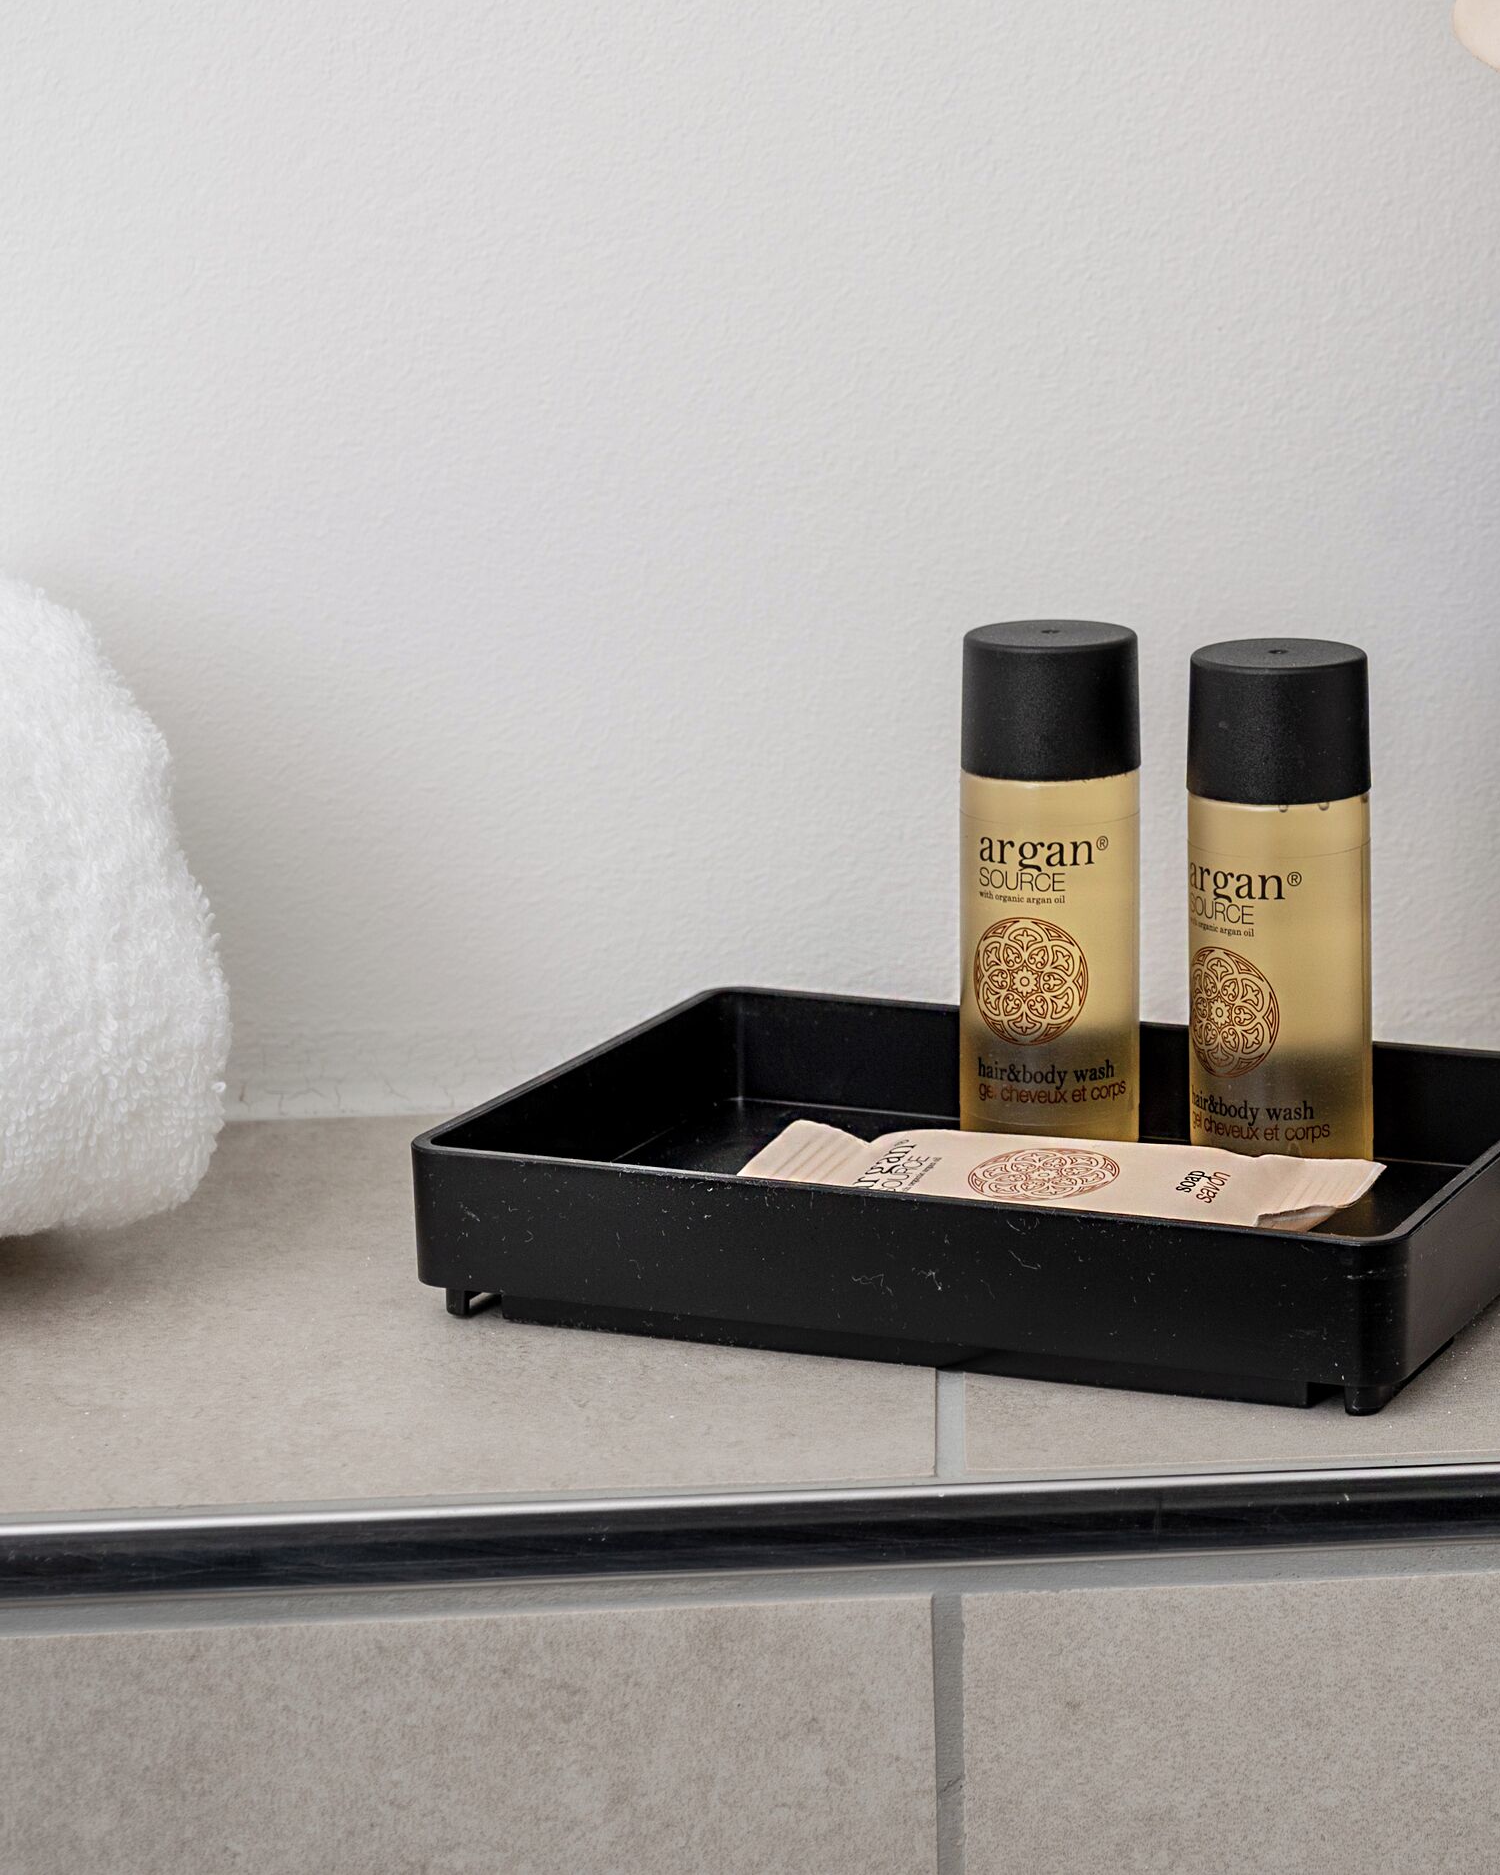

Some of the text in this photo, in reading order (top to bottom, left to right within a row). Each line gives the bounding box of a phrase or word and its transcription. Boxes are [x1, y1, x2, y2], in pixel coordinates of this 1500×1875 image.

[979, 866, 1066, 892] SOURCE
[979, 890, 1066, 905] with organic argan oil
[1190, 892, 1255, 925] SOURCE
[1219, 927, 1242, 936] argan
[1243, 928, 1255, 937] oil
[978, 1056, 1115, 1091] hair&body wash
[1001, 1085, 1068, 1104] cheveux
[1072, 1085, 1087, 1103] et
[1091, 1080, 1127, 1101] corps
[1265, 1100, 1315, 1121] wash
[1204, 1115, 1260, 1141] cheveux
[1263, 1124, 1280, 1141] et
[1284, 1123, 1331, 1143] corps
[876, 1155, 930, 1193] OURCE
[1175, 1170, 1212, 1194] soap
[1195, 1171, 1232, 1204] savon
